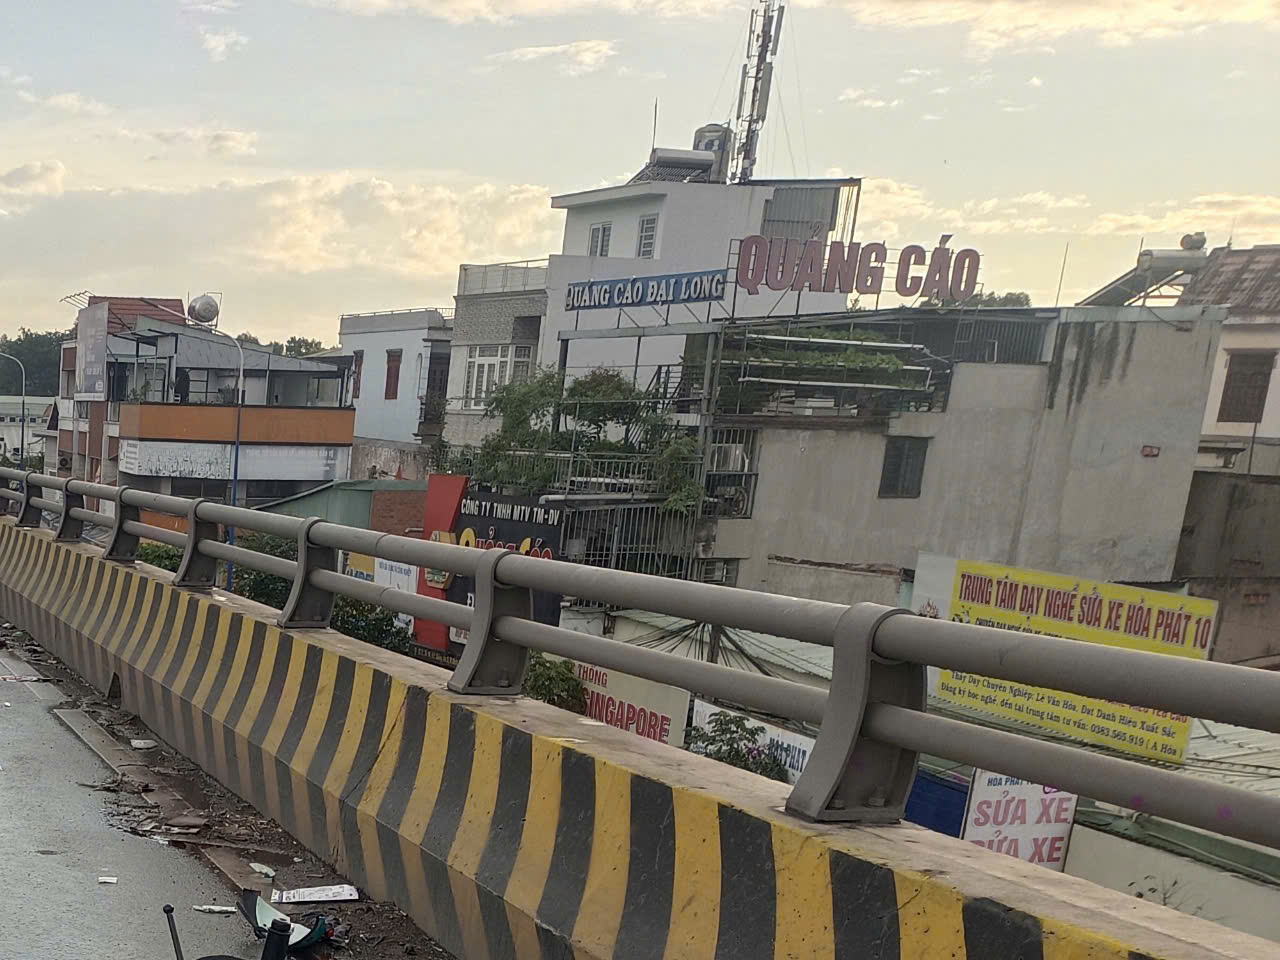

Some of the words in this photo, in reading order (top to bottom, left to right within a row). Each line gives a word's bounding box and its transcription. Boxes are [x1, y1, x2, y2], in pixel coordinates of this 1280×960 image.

[737, 222, 887, 295] QUẢNG
[896, 234, 981, 300] CÁO
[680, 274, 725, 300] LONG
[461, 496, 479, 515] CÔNG
[481, 502, 492, 517] TY
[493, 503, 512, 519] TNHH
[512, 505, 531, 522] MTV
[532, 507, 560, 526] TM-DV
[960, 573, 993, 606] TRUNG
[994, 575, 1019, 610] TÂM
[1019, 584, 1043, 620] DẠY
[1043, 583, 1079, 622] NGHỀ
[1078, 587, 1104, 628] SỬA
[1104, 600, 1124, 631] XE
[1152, 606, 1191, 645] PHÁT
[1193, 617, 1212, 649] 10
[582, 686, 671, 744] SINGAPORE
[974, 790, 1026, 827] SỬA
[1035, 797, 1072, 824] XE
[1029, 836, 1065, 863] XE
